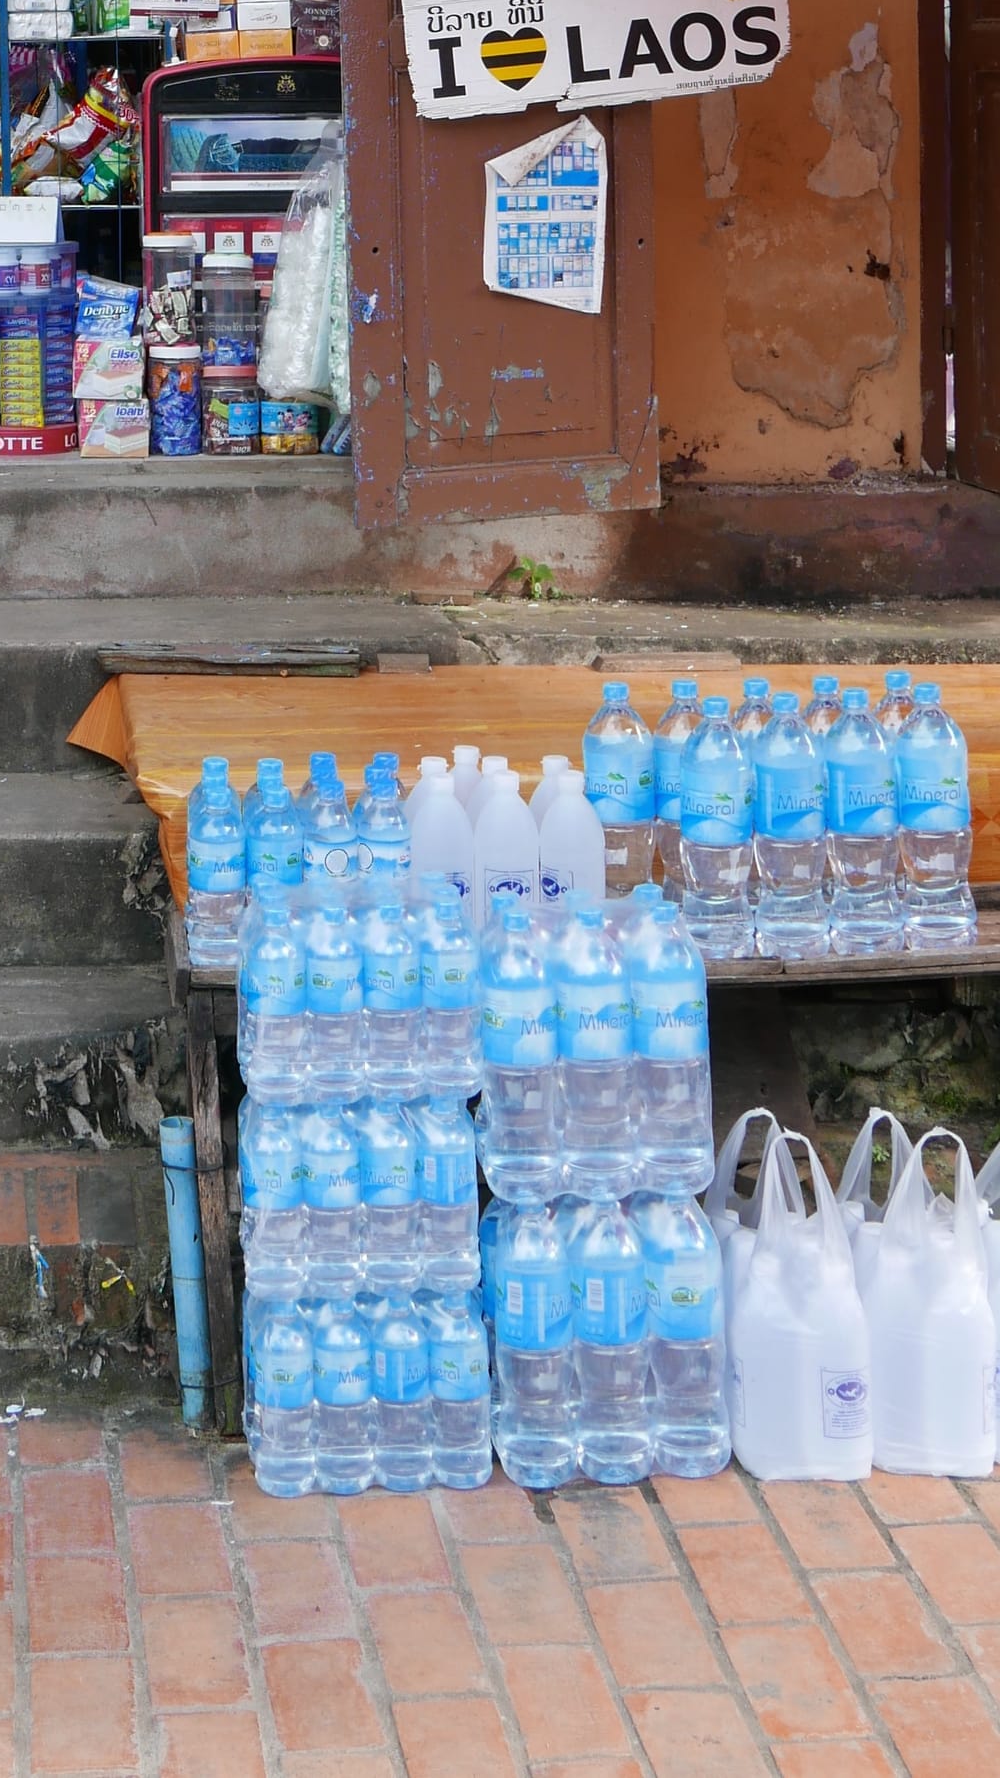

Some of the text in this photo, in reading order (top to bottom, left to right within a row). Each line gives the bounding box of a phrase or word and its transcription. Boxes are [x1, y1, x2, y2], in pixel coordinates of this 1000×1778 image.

[427, 5, 493, 33] ບີລາຍ
[428, 6, 781, 99] I LAOS
[83, 303, 130, 318] Dentyne
[904, 784, 961, 802] Mineral
